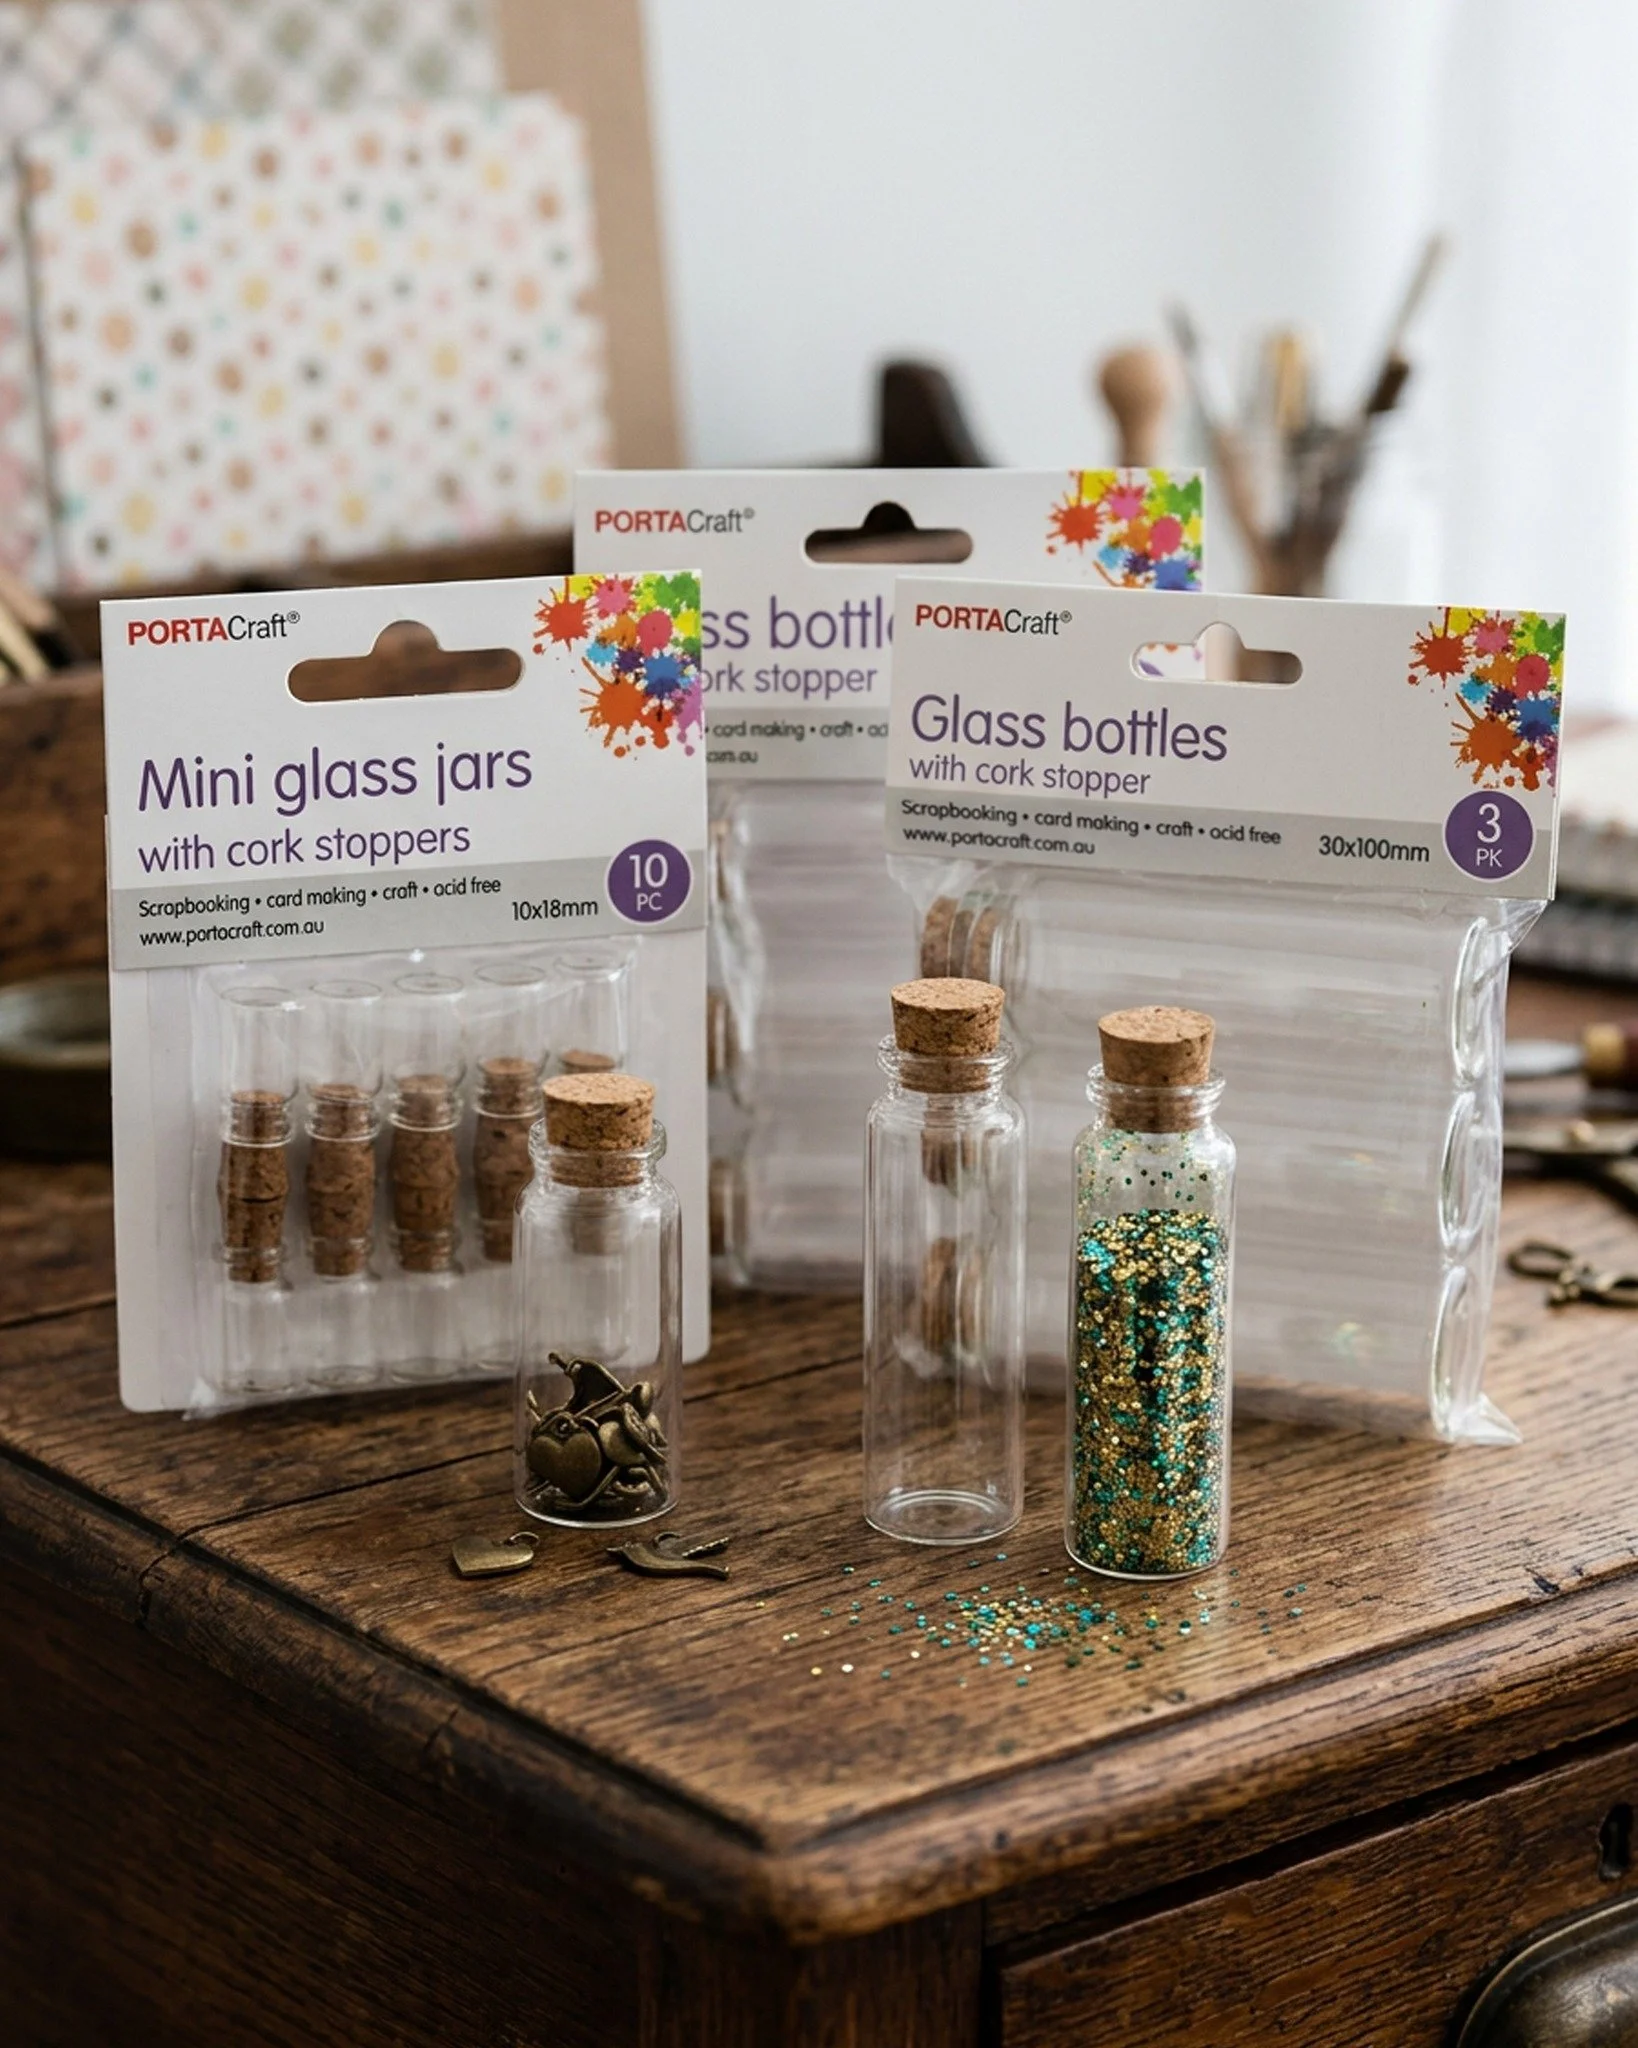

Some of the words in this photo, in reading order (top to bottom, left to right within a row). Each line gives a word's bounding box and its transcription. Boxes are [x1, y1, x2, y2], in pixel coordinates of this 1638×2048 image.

[770, 596, 893, 649] bottl
[754, 664, 877, 700] stopper
[911, 693, 1046, 749] Glass
[1063, 701, 1228, 762] bottles
[138, 752, 254, 812] Mini
[274, 746, 418, 817] glass
[437, 742, 532, 806] jars
[909, 753, 966, 783] with
[975, 758, 1035, 787] cork
[1043, 763, 1151, 799] stopper
[901, 799, 1017, 827] Scrapbooking
[1034, 811, 1072, 829] card
[1076, 814, 1139, 837] making
[1156, 821, 1193, 837] craft
[1209, 825, 1245, 843] acid
[1249, 825, 1282, 845] free
[1476, 802, 1501, 843] 3
[138, 834, 215, 873] with
[227, 828, 304, 868] cork
[315, 825, 470, 866] stoppers
[1318, 835, 1430, 863] 30x100mm
[1476, 848, 1502, 868] PK
[629, 852, 669, 889] 10
[138, 896, 250, 919] Scrapbooking
[266, 890, 303, 909] card
[307, 885, 367, 907] making
[383, 881, 418, 900] craft
[433, 877, 467, 897] acid
[471, 876, 501, 893] free
[512, 899, 599, 921] 10x18mm
[636, 892, 662, 912] PC
